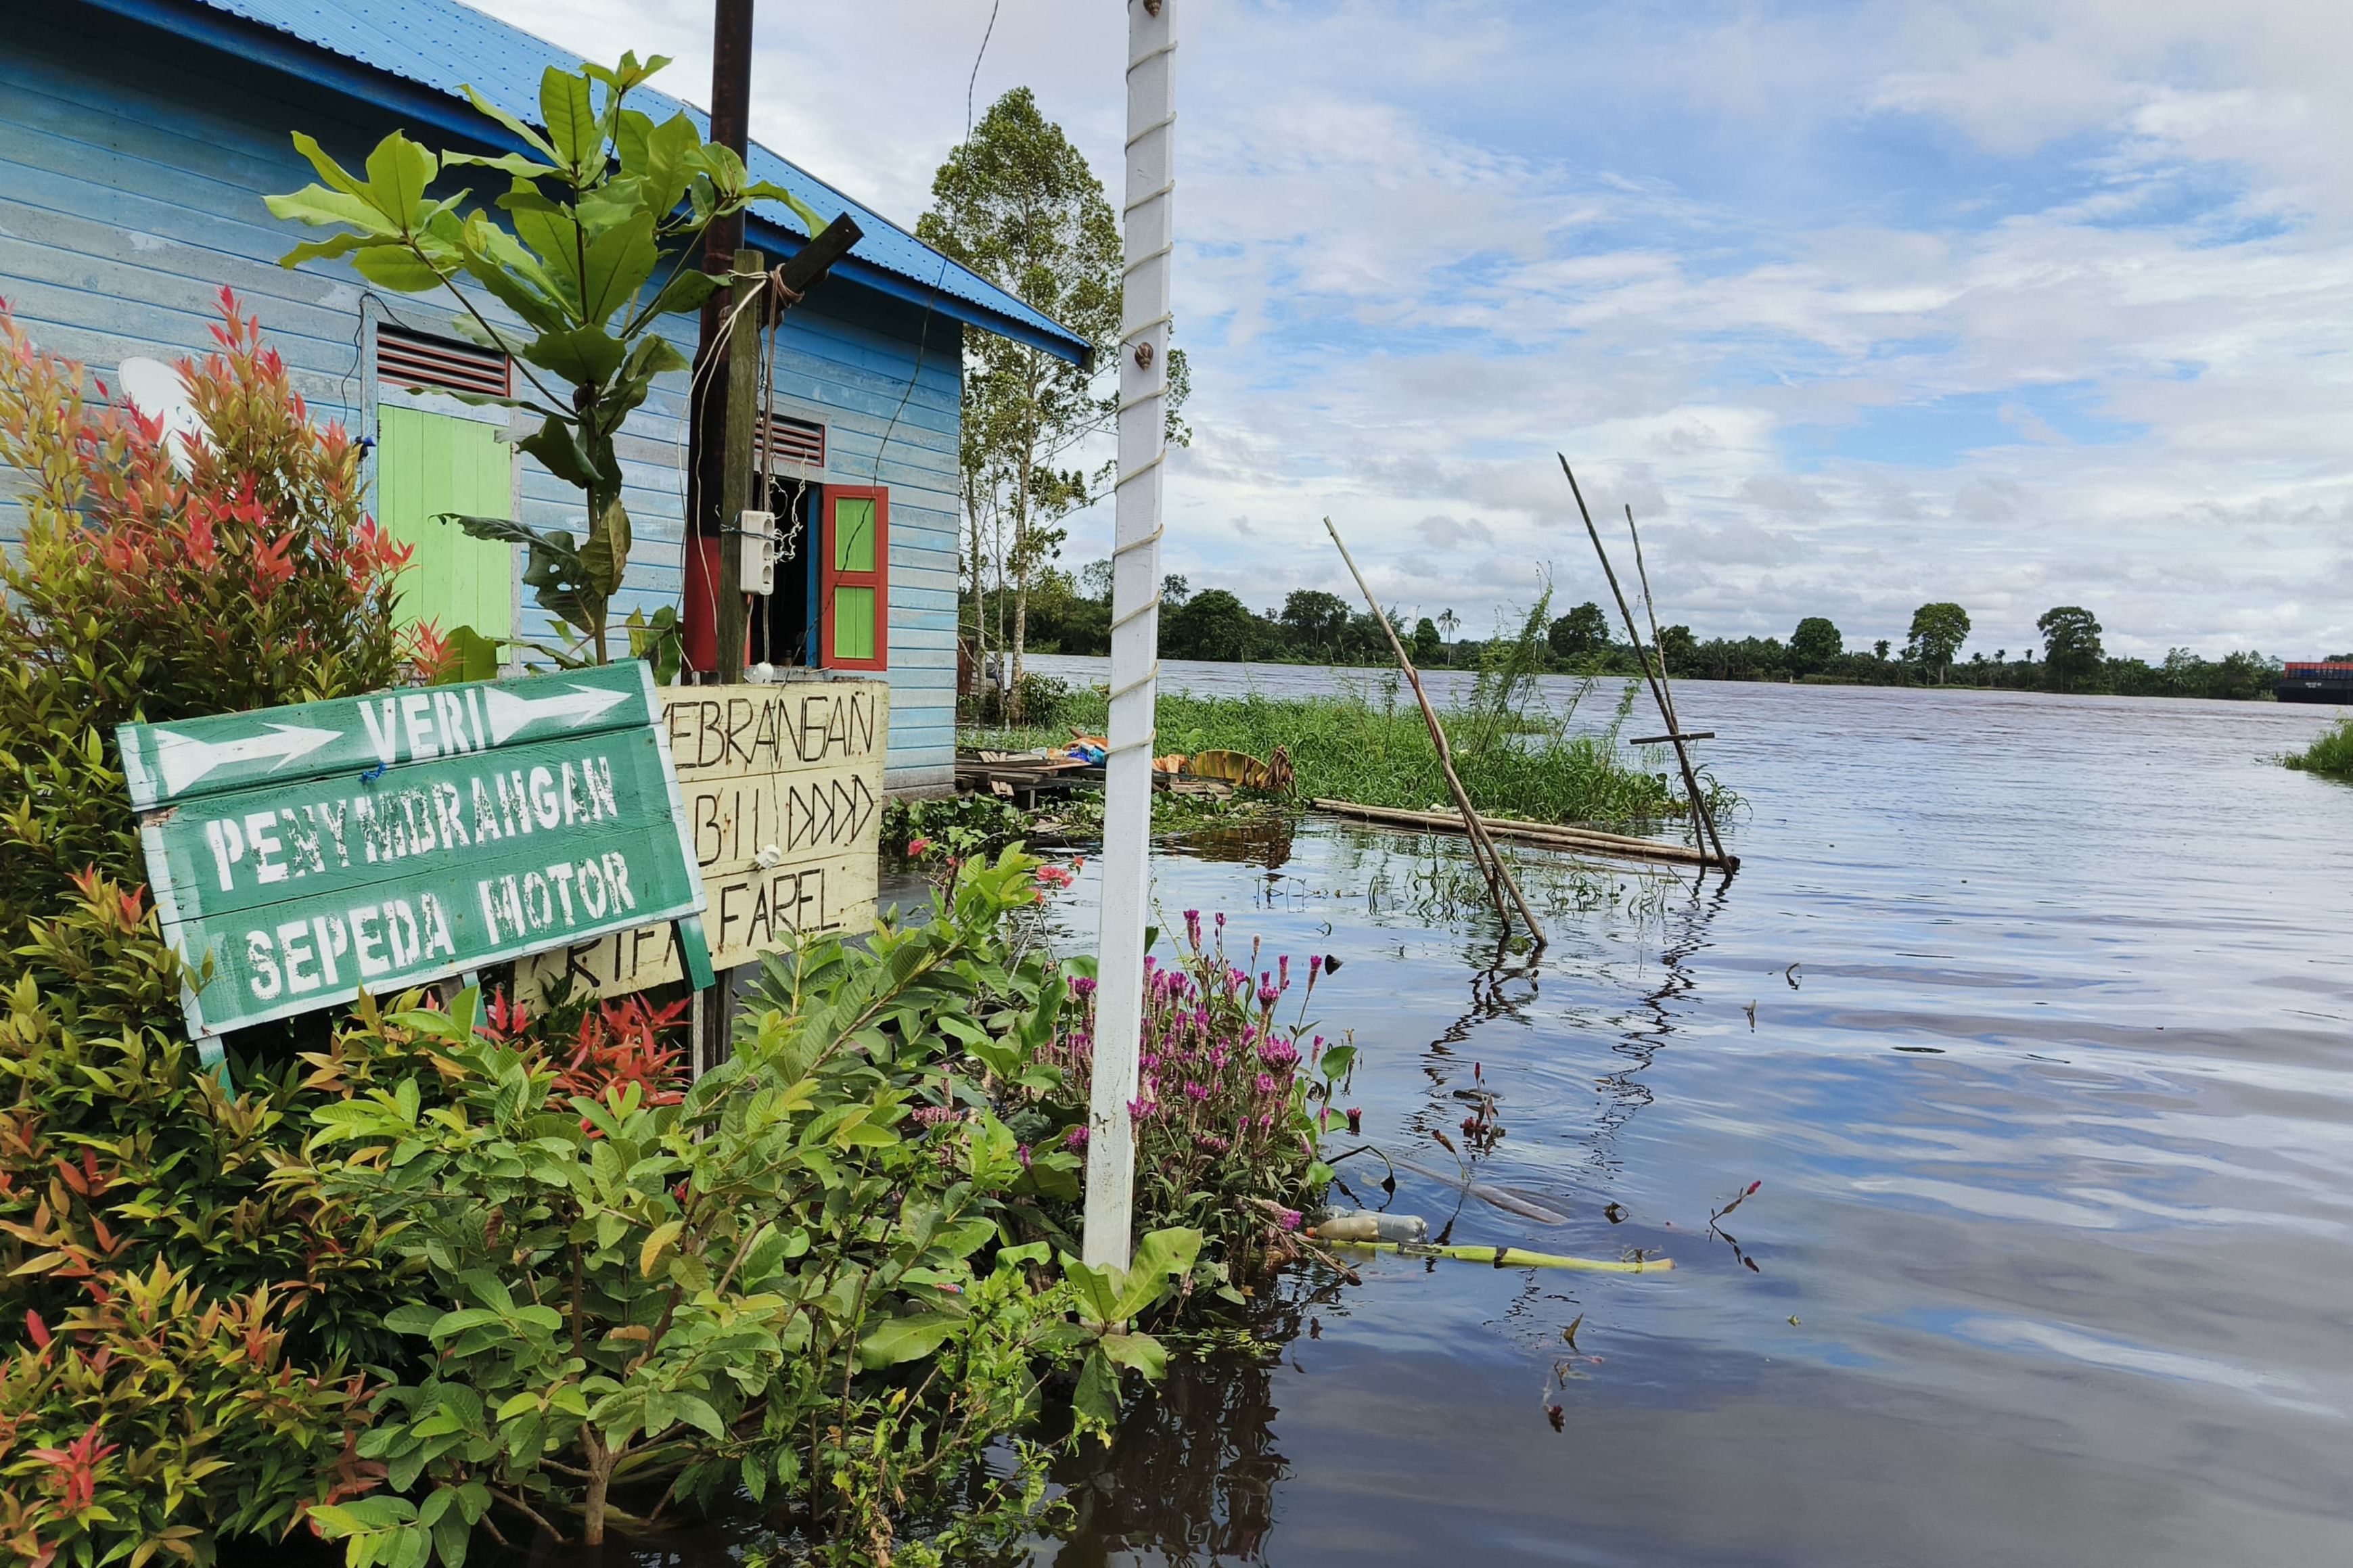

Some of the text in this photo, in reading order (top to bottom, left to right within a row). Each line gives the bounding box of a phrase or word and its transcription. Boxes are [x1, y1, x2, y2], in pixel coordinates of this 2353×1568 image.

[357, 689, 486, 764] VERI
[662, 694, 874, 769] EBRANGAN
[245, 852, 636, 1000] SEPEDA MOTOR
